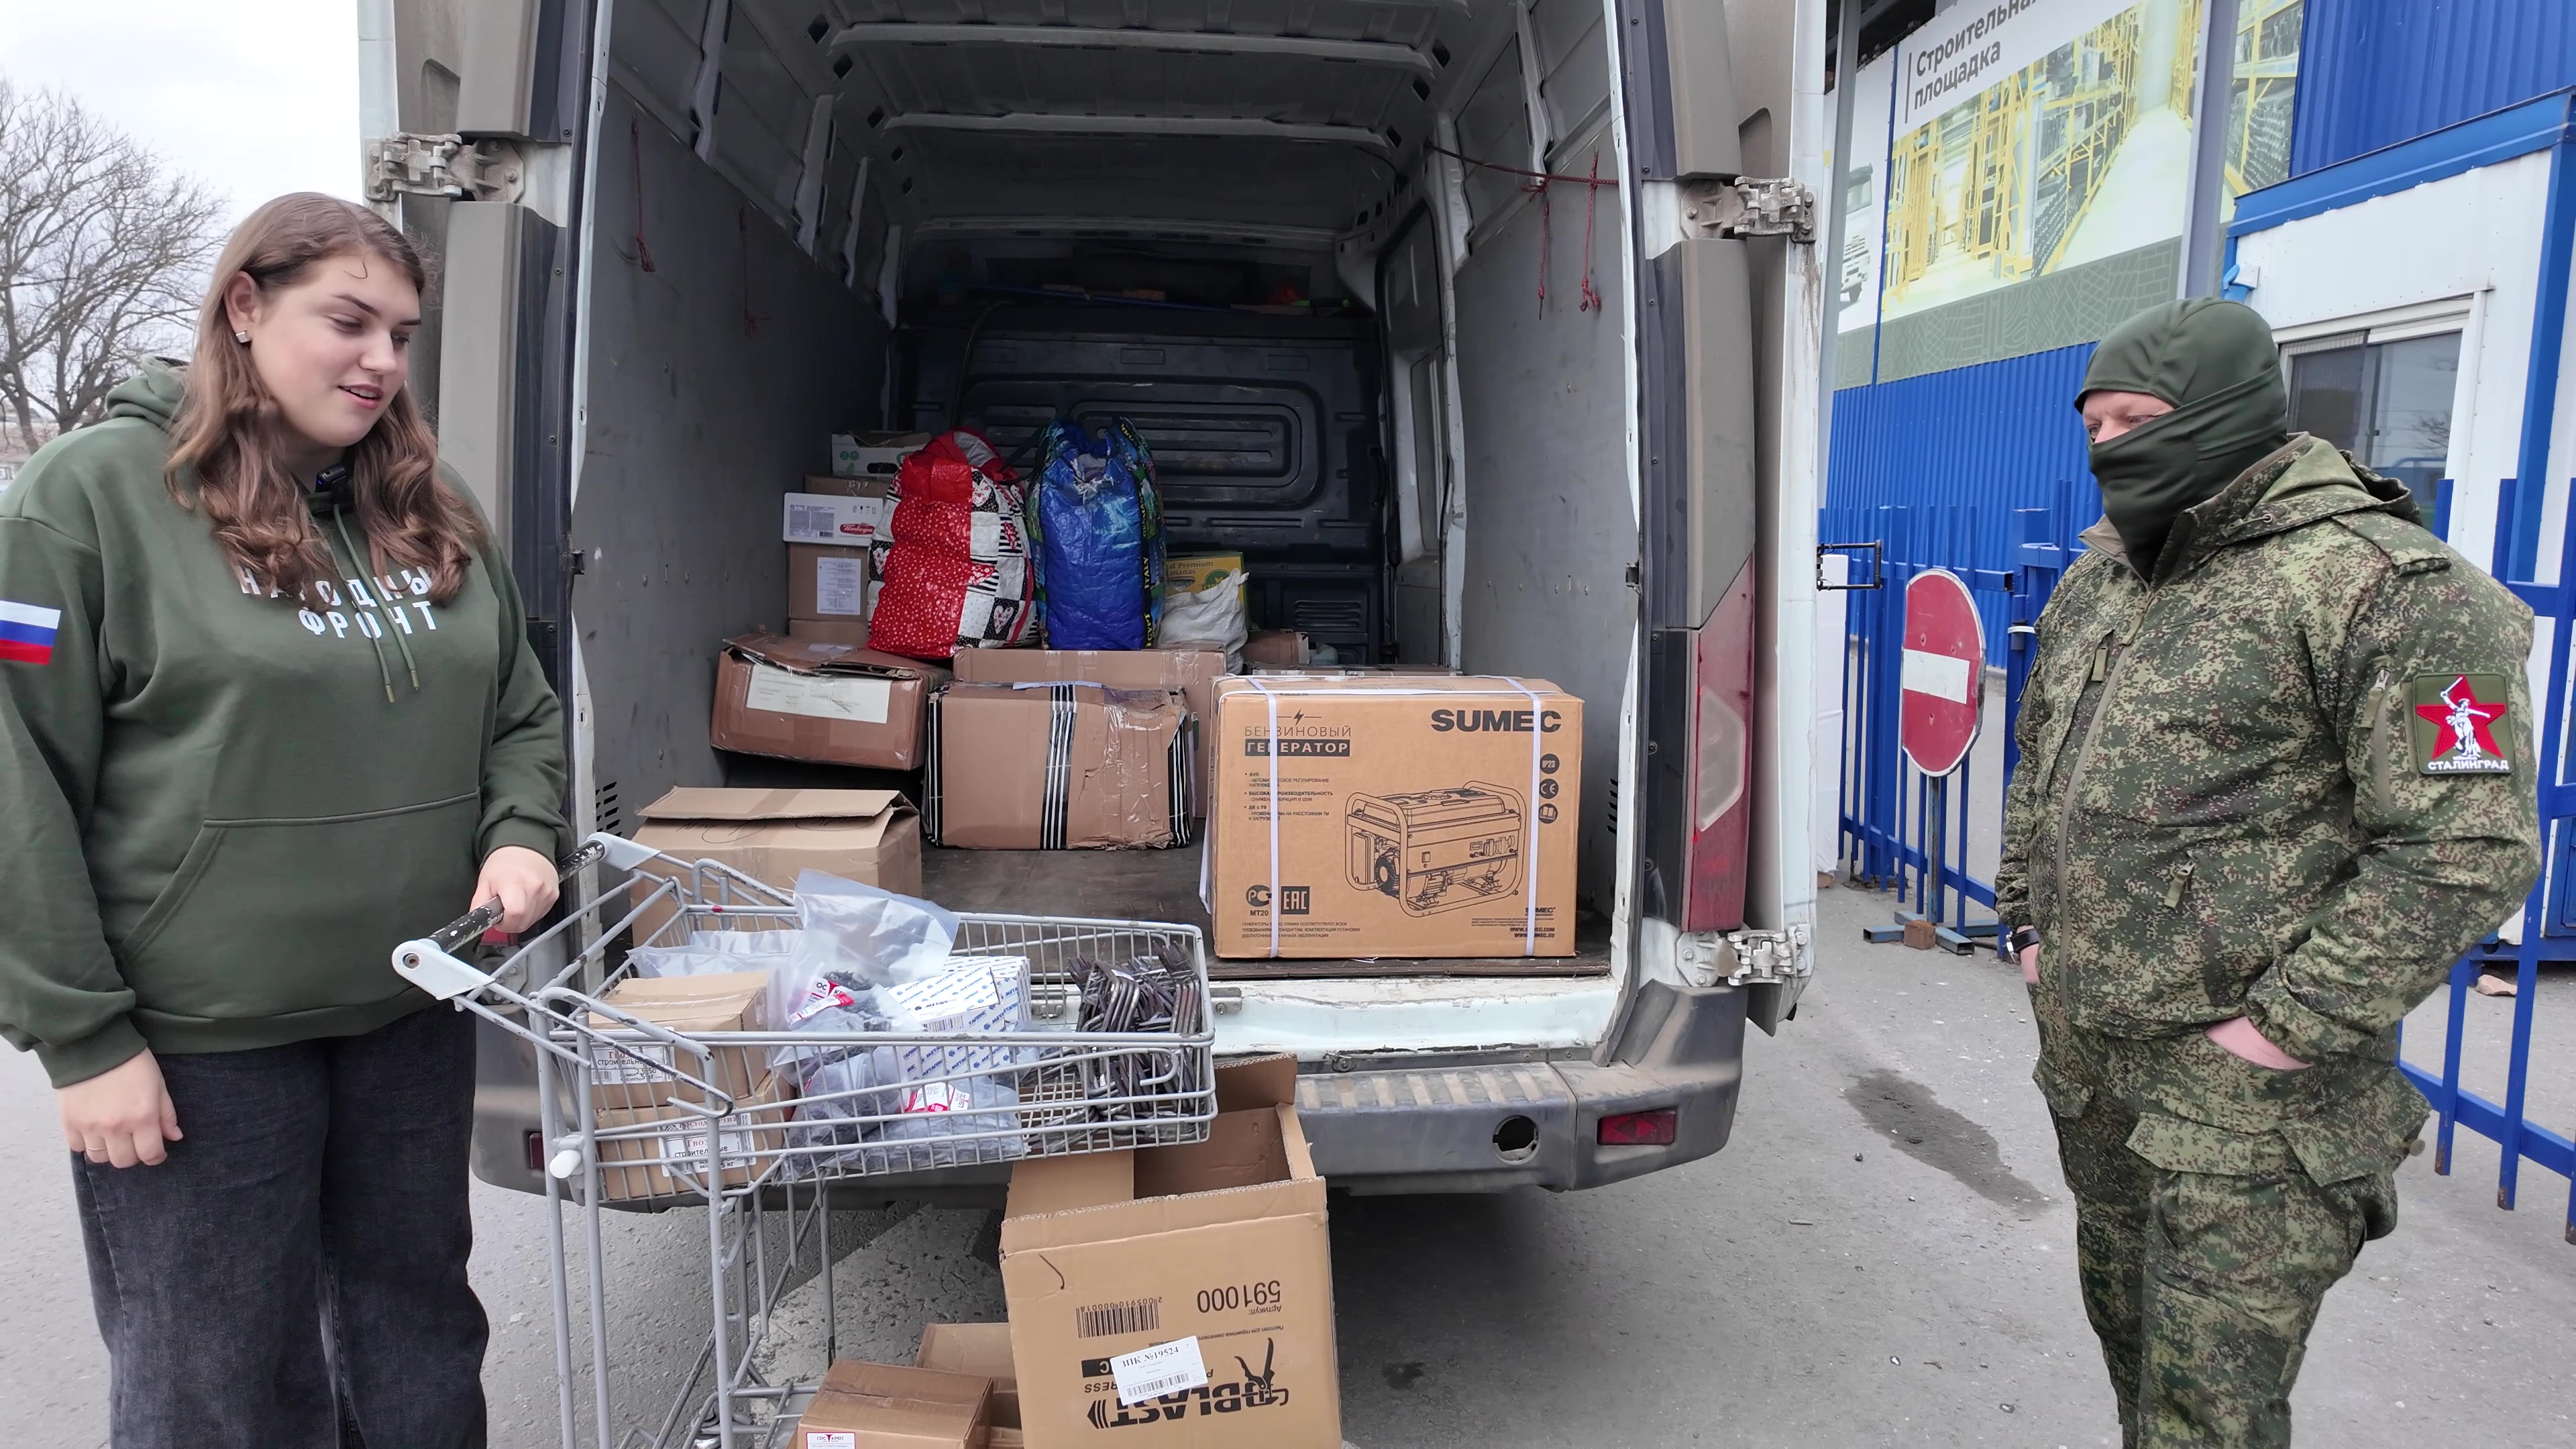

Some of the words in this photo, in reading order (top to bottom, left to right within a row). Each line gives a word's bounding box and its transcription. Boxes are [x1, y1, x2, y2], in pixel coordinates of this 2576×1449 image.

[1917, 0, 2036, 77] Строительна
[1915, 41, 2000, 110] площадка
[1178, 561, 1214, 569] Premium
[299, 600, 437, 639] ФРОНТ
[1431, 709, 1562, 733] SUMEC
[1245, 725, 1351, 737] БЕНЗИНОВЫЙ
[1542, 760, 1556, 768] IP23
[2428, 759, 2510, 771] СТАЛИНГРАД
[1283, 891, 1307, 910] EAC
[1119, 1297, 1154, 1307] 005910
[1196, 1280, 1281, 1313] 591000
[1080, 1302, 1115, 1312] 000018
[1248, 1305, 1282, 1315] Артикул:
